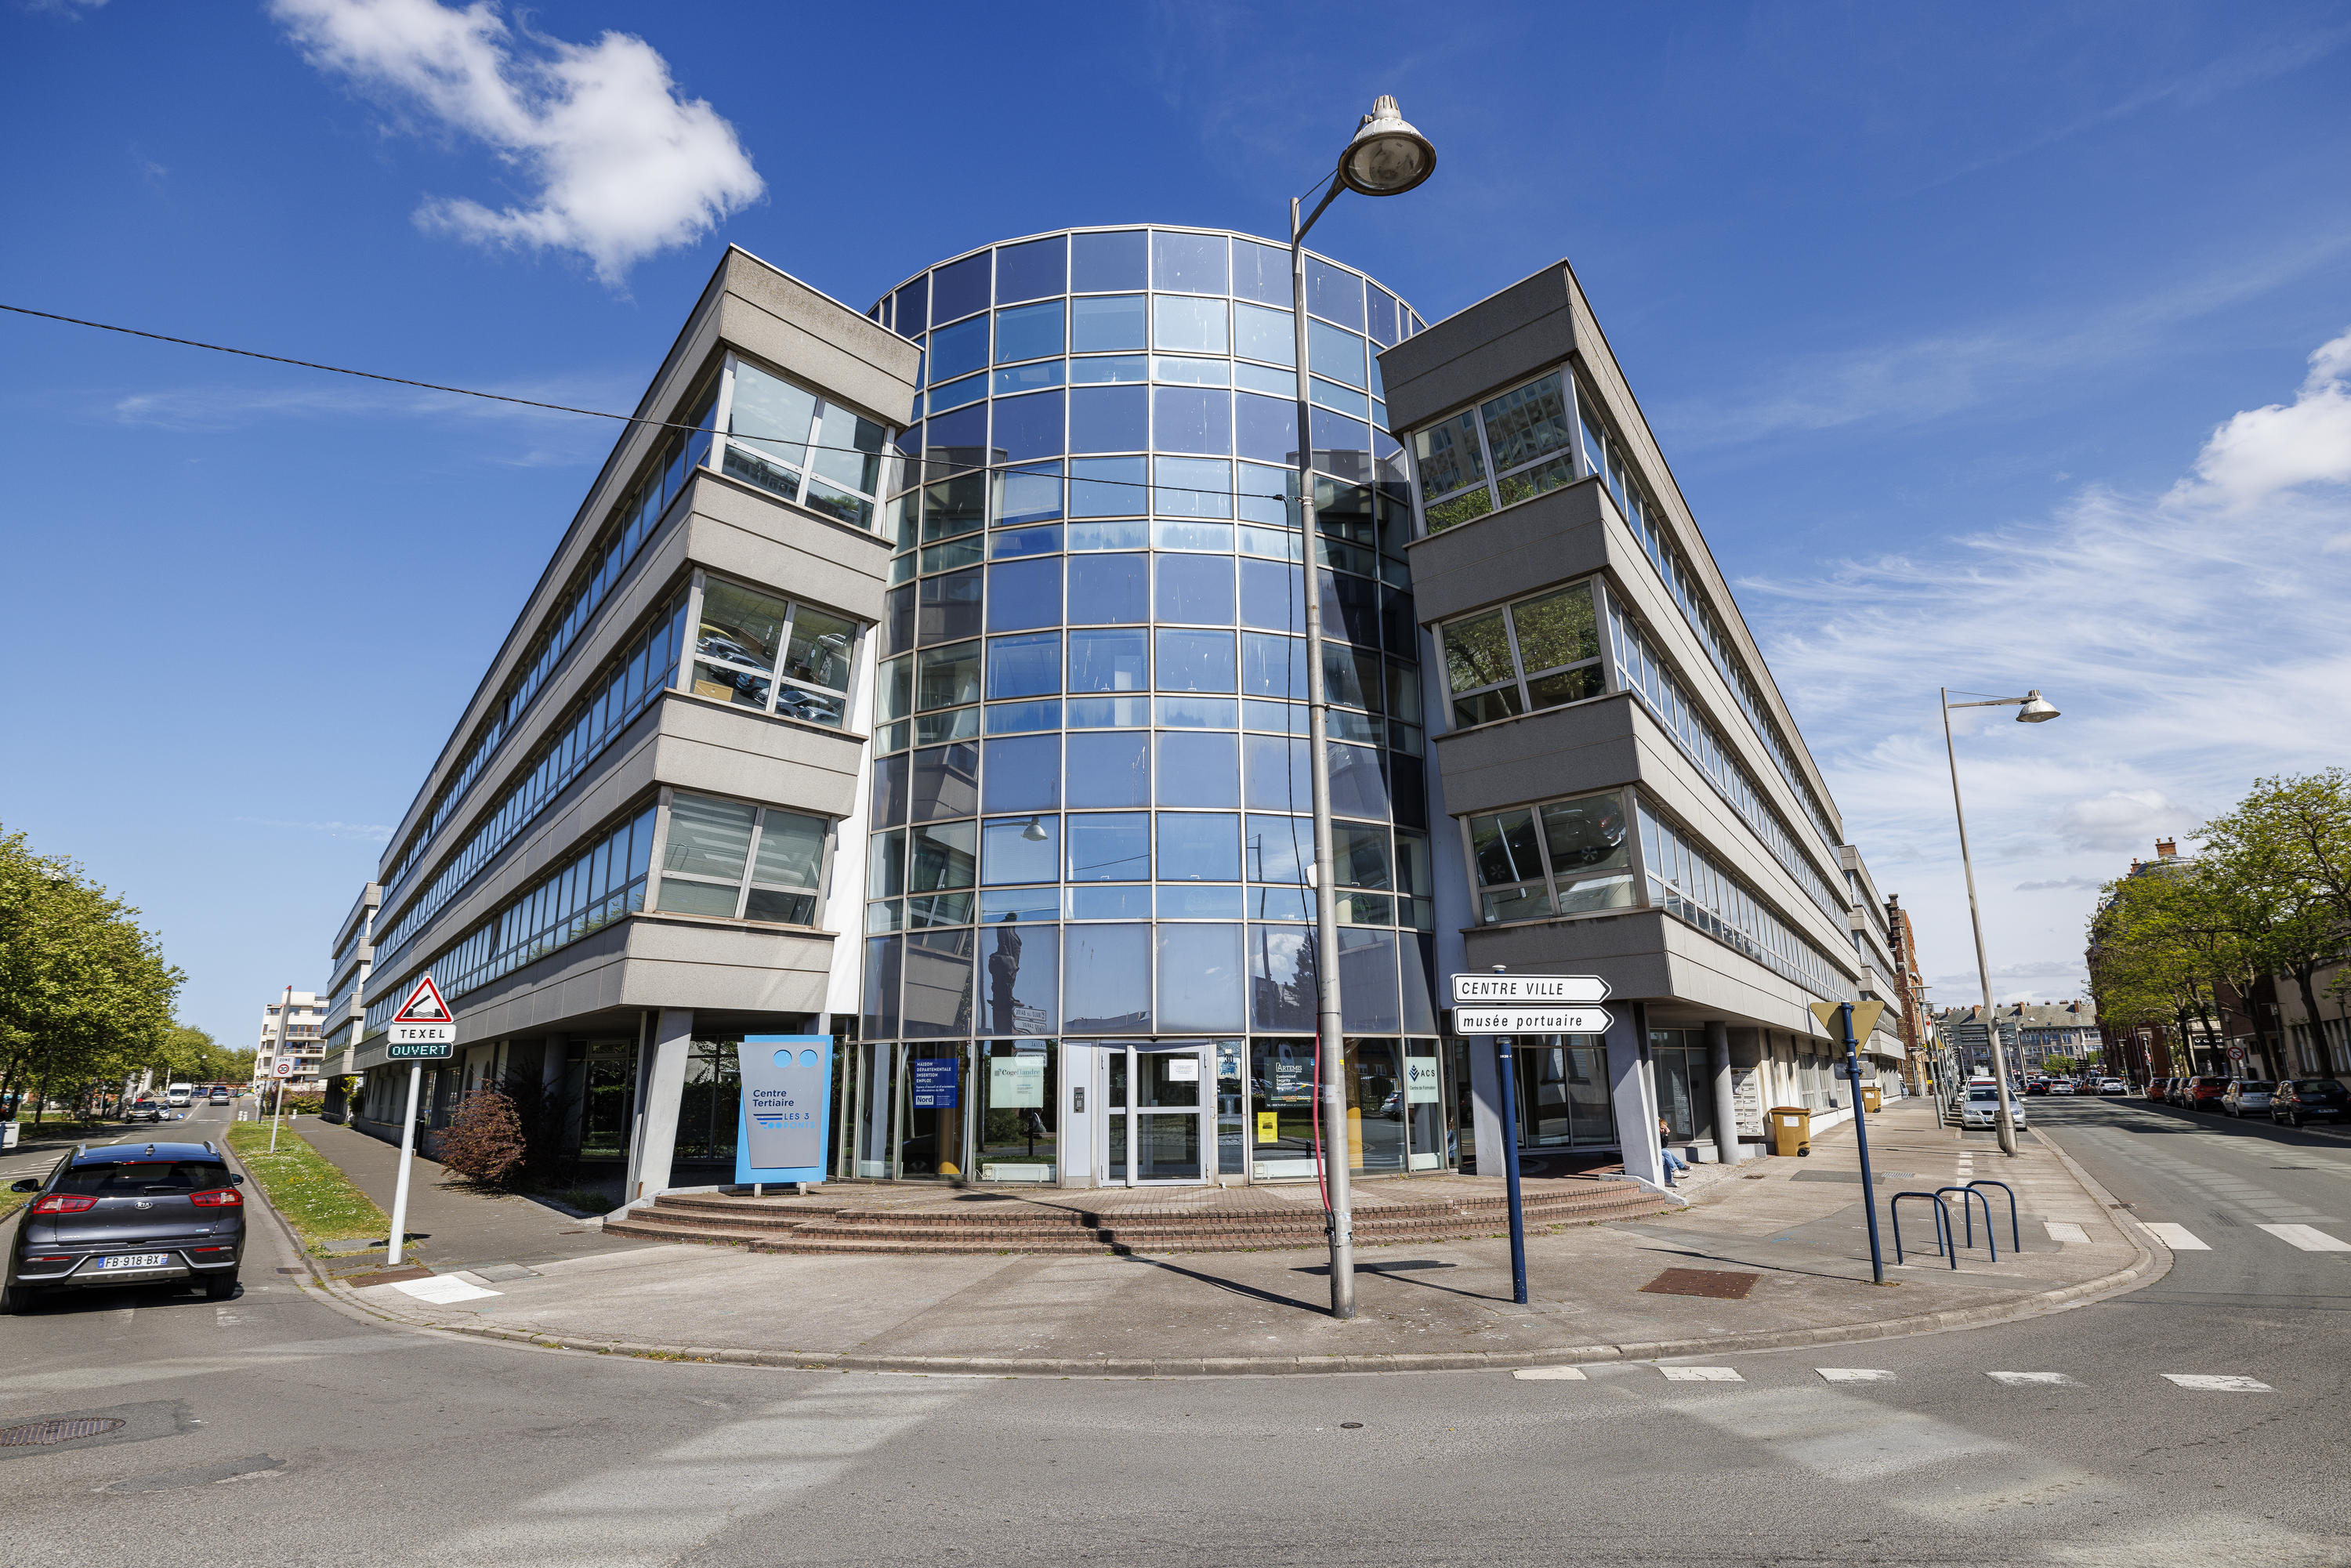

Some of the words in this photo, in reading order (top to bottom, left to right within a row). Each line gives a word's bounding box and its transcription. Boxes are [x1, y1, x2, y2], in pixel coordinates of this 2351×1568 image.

[1462, 982, 1517, 995] CENTRE
[1527, 983, 1563, 995] VILLE
[1463, 1014, 1509, 1027] musée
[1516, 1014, 1582, 1030] portuaire
[400, 1029, 445, 1038] TEXEL
[392, 1045, 447, 1056] OUVERT
[1224, 1054, 1233, 1063] 30
[1276, 1063, 1302, 1072] ARTEMIS
[1420, 1069, 1436, 1077] ACS
[752, 1099, 795, 1107] Tertiaire
[105, 1255, 160, 1268] FB-918-BX
